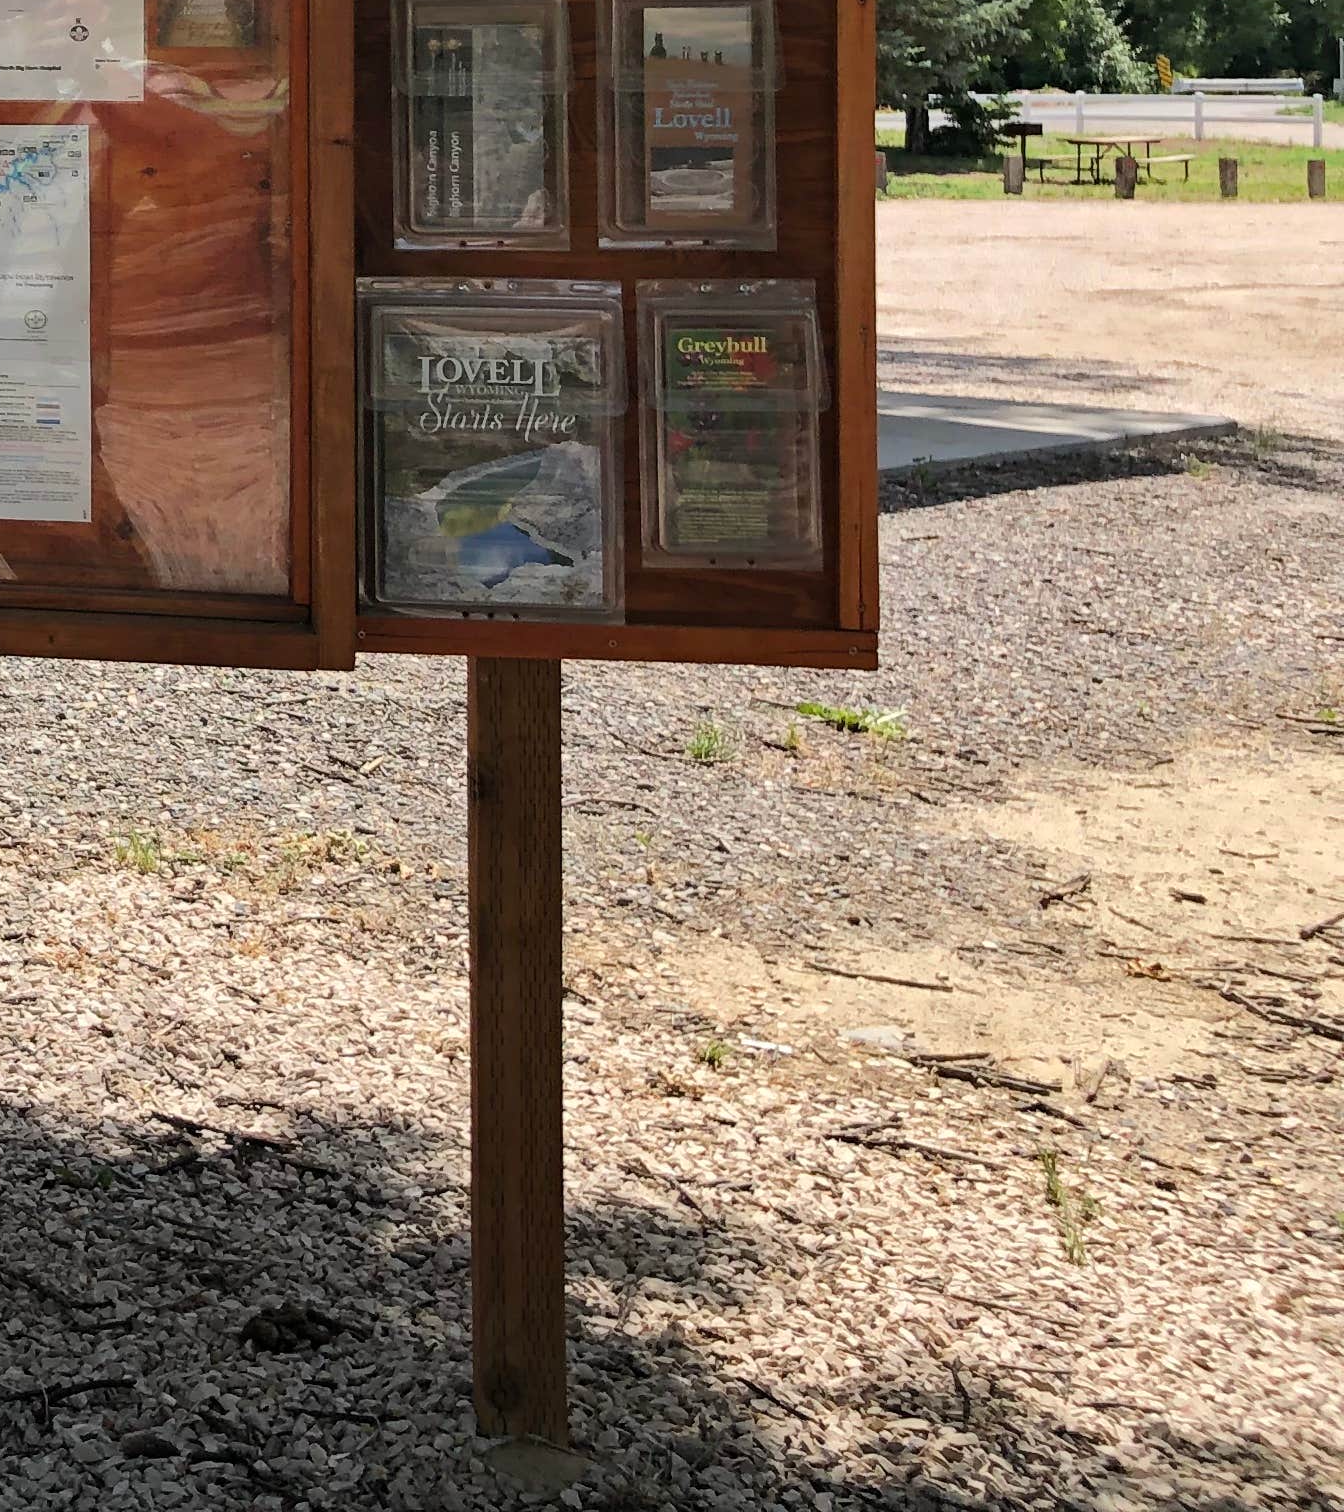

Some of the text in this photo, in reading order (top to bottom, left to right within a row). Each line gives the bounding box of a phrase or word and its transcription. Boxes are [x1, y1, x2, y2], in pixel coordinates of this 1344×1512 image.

[653, 107, 731, 129] Lovell
[449, 131, 463, 173] Canyon
[677, 336, 768, 356] Greybull
[417, 356, 562, 397] LOVELL
[420, 392, 576, 443] Starts Here
